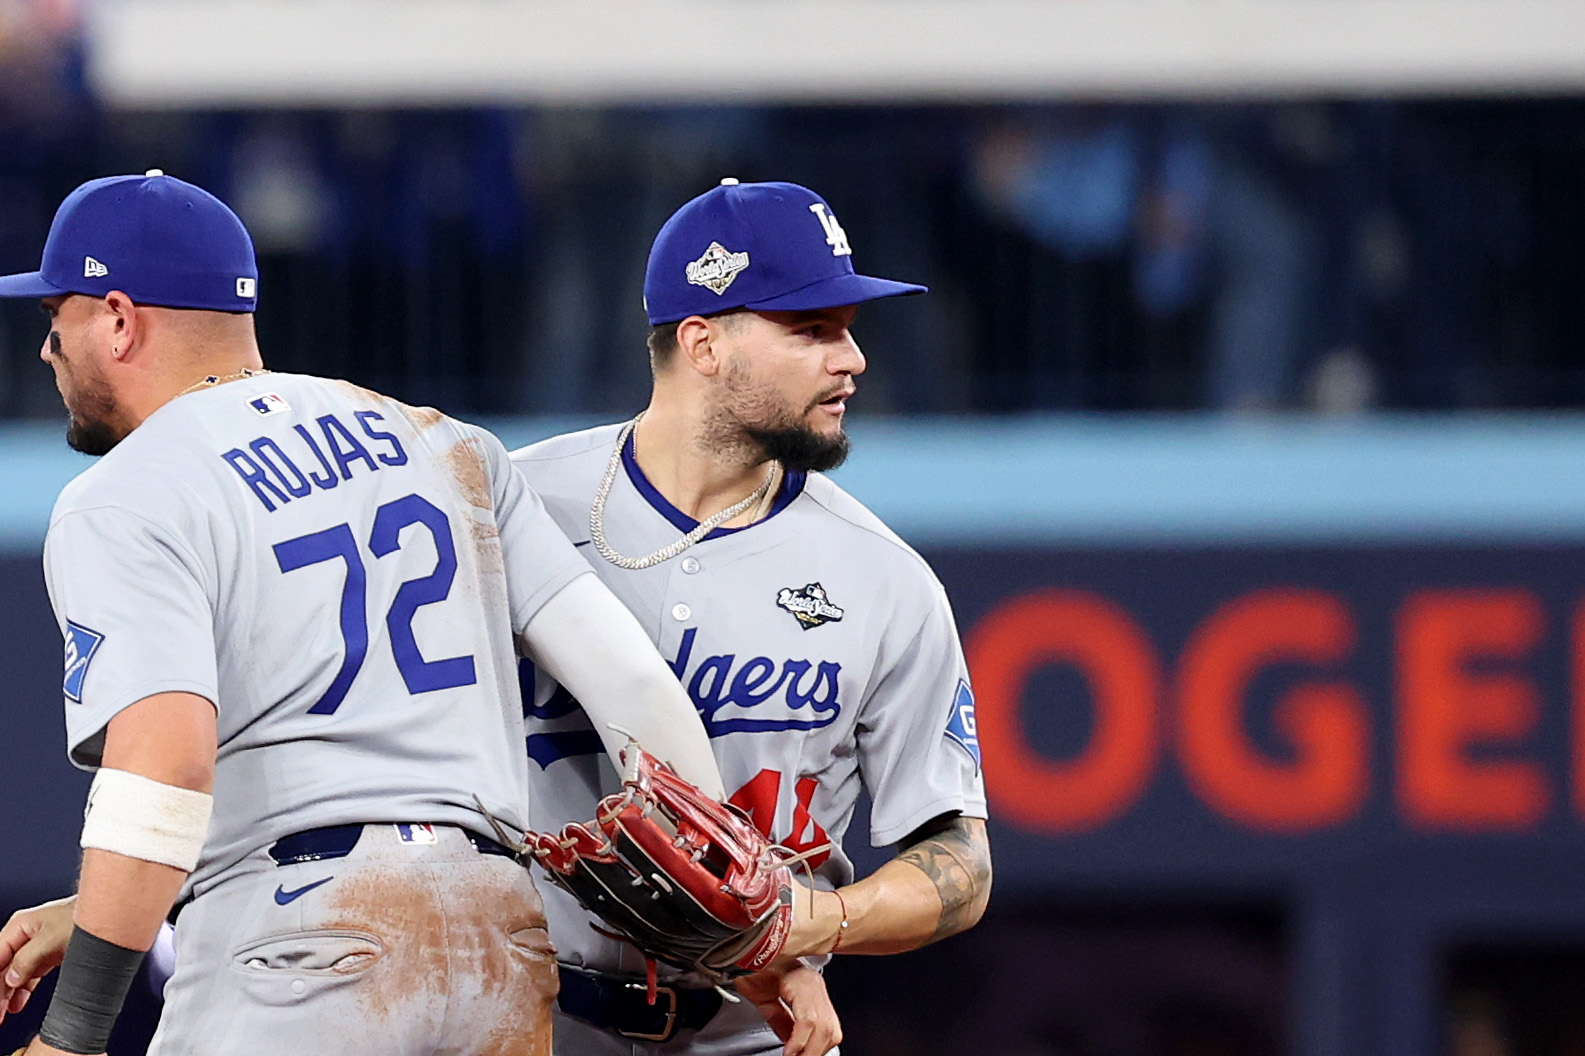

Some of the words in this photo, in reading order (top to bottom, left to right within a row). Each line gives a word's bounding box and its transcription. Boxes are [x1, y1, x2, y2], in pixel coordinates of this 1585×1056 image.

[809, 203, 852, 256] LA
[221, 410, 408, 513] ROJAS
[272, 493, 477, 716] 72
[961, 585, 1585, 838] OGE
